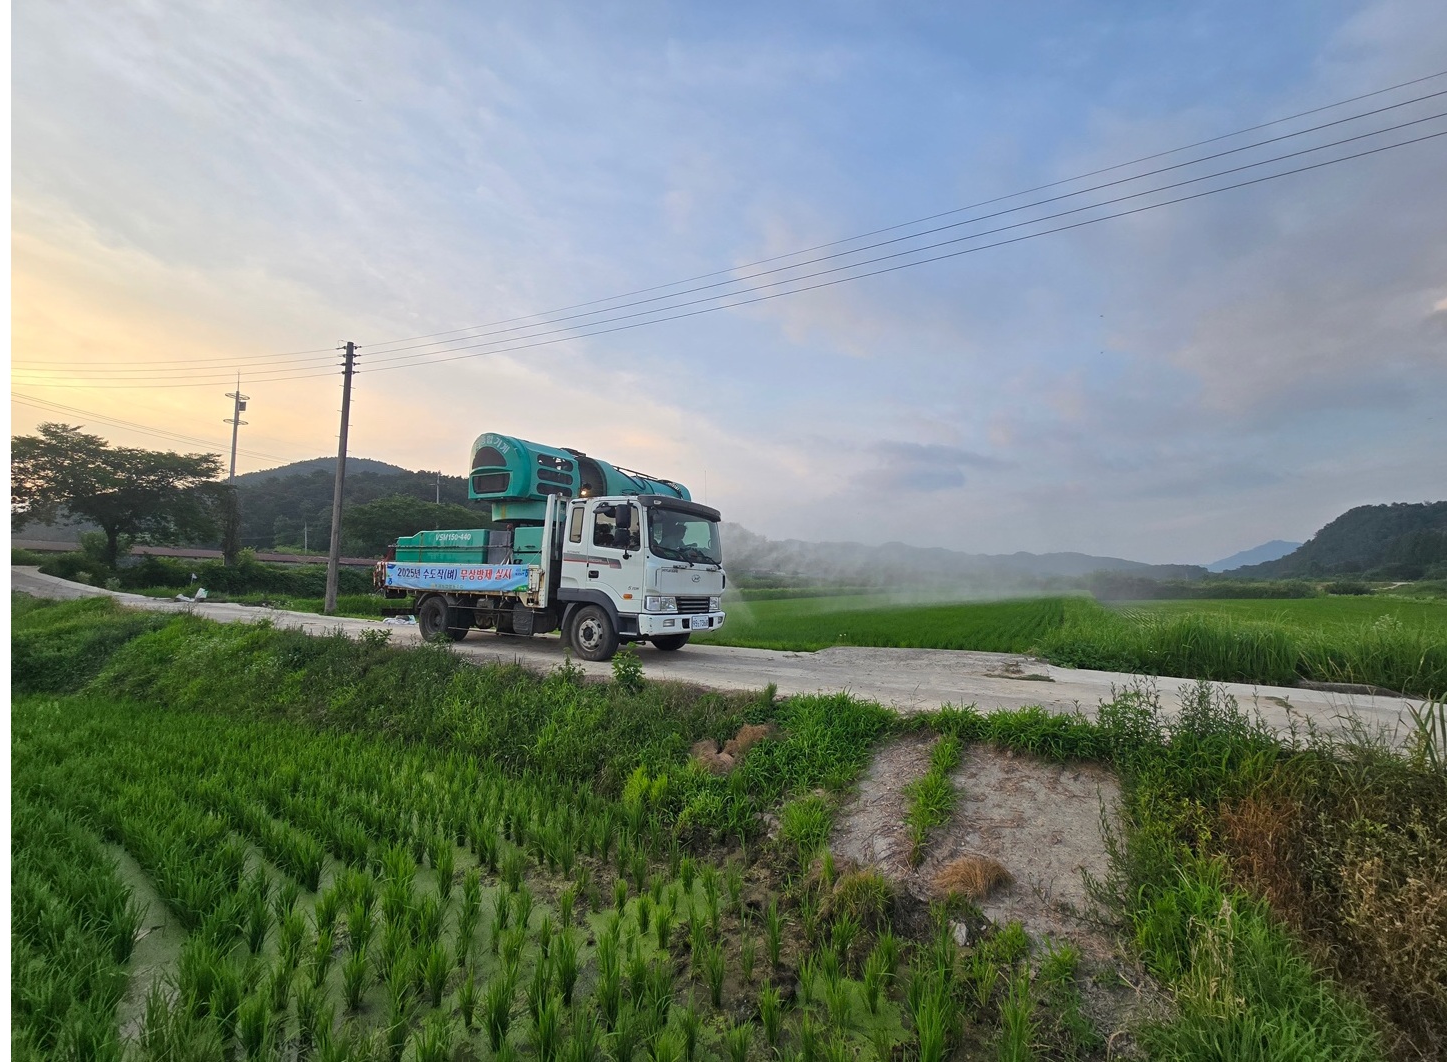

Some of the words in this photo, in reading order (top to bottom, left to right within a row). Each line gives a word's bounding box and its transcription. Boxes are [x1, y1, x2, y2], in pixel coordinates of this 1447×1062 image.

[397, 567, 421, 579] 2025년
[423, 568, 458, 580] 수도작(벼)
[460, 568, 493, 581] 무상방제
[495, 568, 512, 580] 실시
